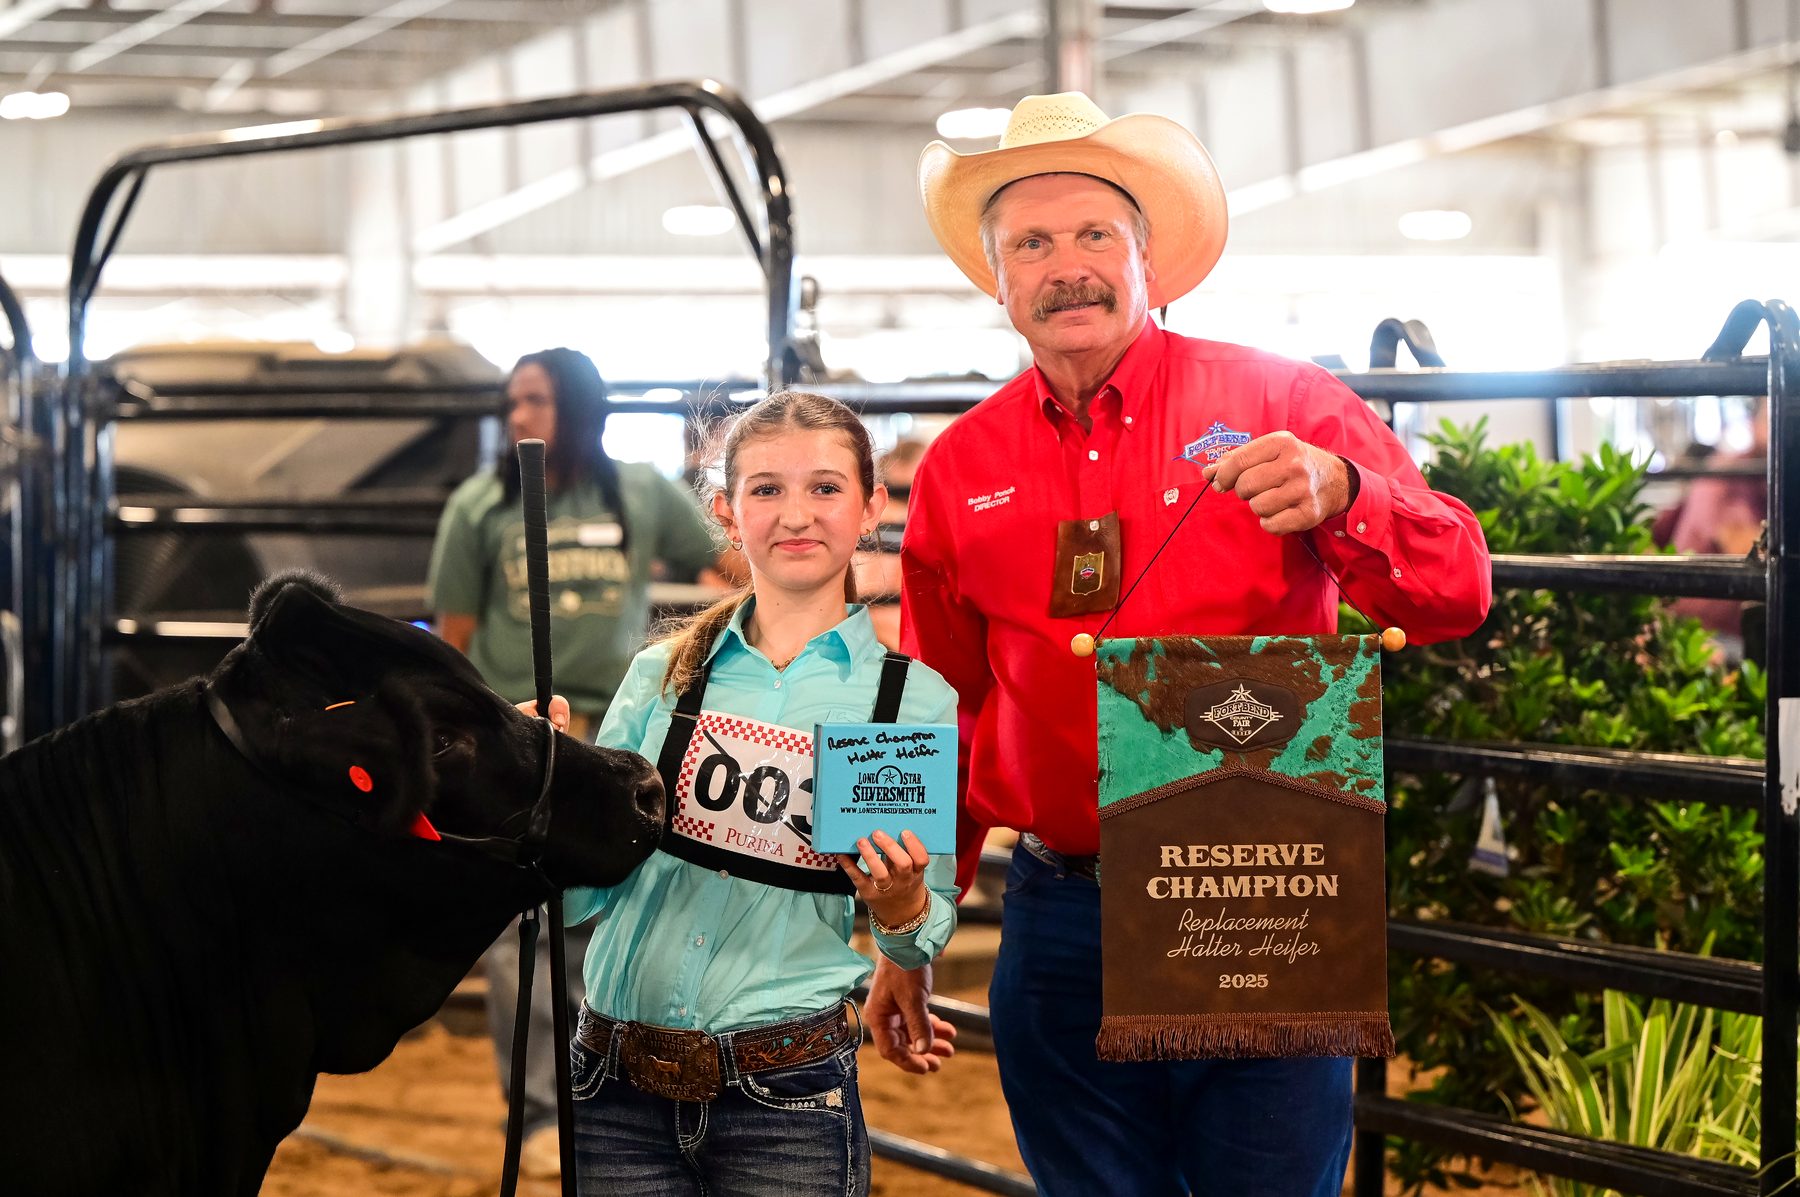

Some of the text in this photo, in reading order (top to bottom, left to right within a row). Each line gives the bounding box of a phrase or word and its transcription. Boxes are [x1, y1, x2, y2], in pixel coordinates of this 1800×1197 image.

[1187, 434, 1250, 457] FORT BEND
[967, 494, 992, 506] Bobby
[974, 496, 1010, 513] DIRECTOR
[1213, 702, 1270, 718] FORT BEND
[858, 772, 923, 785] LONE STAR
[852, 785, 926, 804] SILVERSMITH
[724, 827, 785, 857] PURINA
[1159, 843, 1325, 868] RESERVE
[1146, 874, 1339, 900] CHAMPION
[1178, 907, 1310, 940] Replacement
[1167, 932, 1321, 965] Halter Heifer
[1219, 974, 1269, 989] 2025
